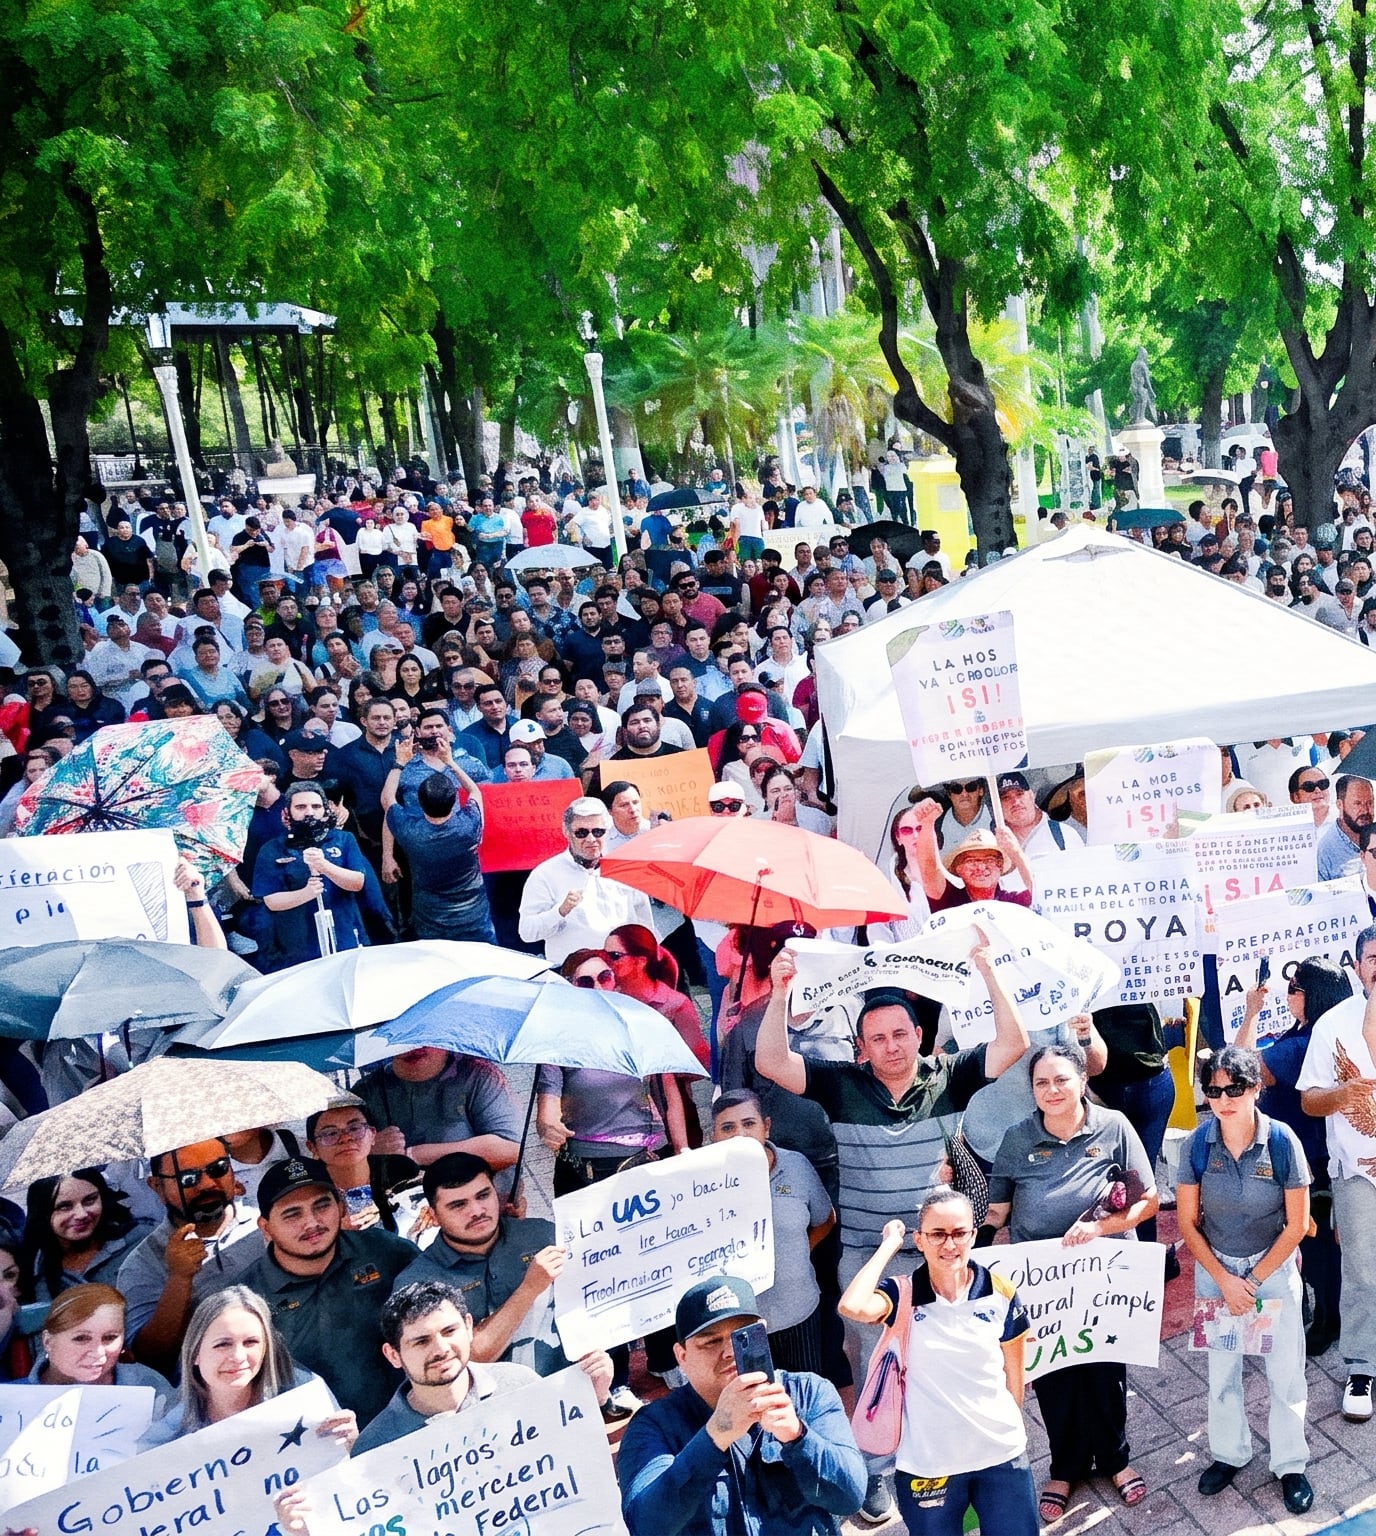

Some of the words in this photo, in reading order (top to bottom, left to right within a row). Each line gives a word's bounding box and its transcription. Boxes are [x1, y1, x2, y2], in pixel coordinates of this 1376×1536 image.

[1044, 878, 1190, 900] PREPARATORIA
[579, 1219, 604, 1239] La
[612, 1189, 662, 1224] UAS
[1093, 1290, 1156, 1318] cimple
[264, 1467, 300, 1495] no
[333, 1488, 390, 1522] Las
[510, 1420, 540, 1447] de
[560, 1400, 584, 1427] la
[58, 1446, 252, 1533] Gobierno
[475, 1465, 580, 1536] Federal
